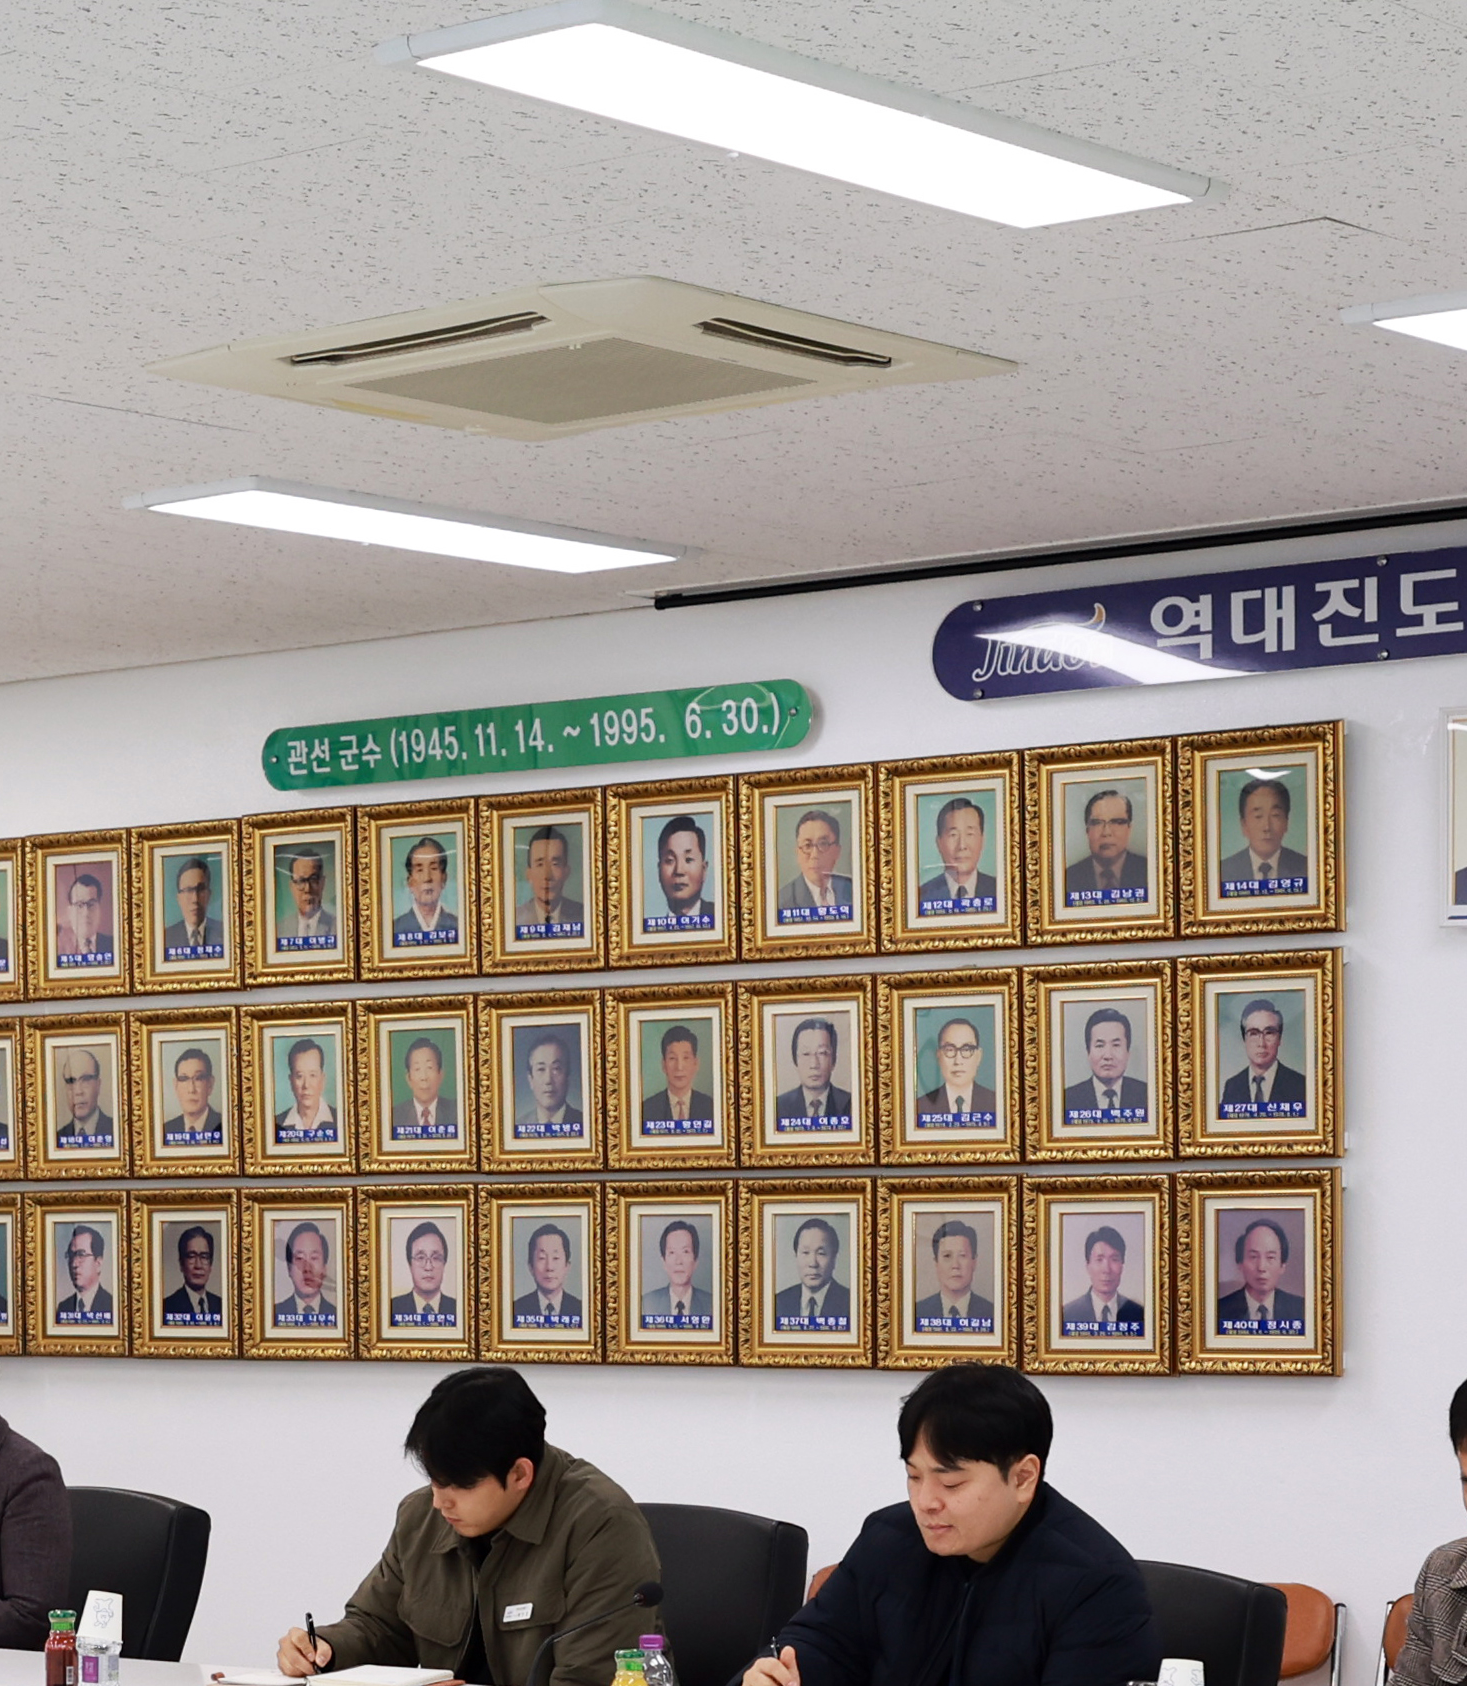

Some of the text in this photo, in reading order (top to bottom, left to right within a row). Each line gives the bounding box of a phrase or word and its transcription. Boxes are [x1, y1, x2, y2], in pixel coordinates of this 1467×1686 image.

[287, 737, 332, 776] 관선
[338, 734, 383, 771] 군수
[389, 725, 467, 769] (1945.
[475, 722, 507, 757] 11.
[515, 718, 555, 754] 14.
[591, 706, 665, 748] 1995.
[684, 700, 713, 739] 6.
[721, 694, 781, 737] 30.)
[1223, 1103, 1258, 1113] 제27대
[921, 1113, 953, 1123] 제25대
[1068, 1109, 1102, 1120] 제26대
[646, 1120, 675, 1129] 제23대
[780, 1117, 812, 1127] 제24대
[396, 1126, 422, 1135] 제21대
[517, 1124, 546, 1133] 제22대
[279, 1130, 304, 1138] 제20대
[59, 1311, 82, 1319] 제31대
[167, 1312, 191, 1321] 제32대
[277, 1313, 304, 1322] 제33대
[394, 1313, 422, 1322] 제34대
[516, 1314, 545, 1323] 제35대
[645, 1315, 675, 1324] 제36대
[780, 1316, 809, 1326] 제37대
[919, 1317, 952, 1327] 제38대
[1222, 1320, 1259, 1329] 제40대
[1065, 1322, 1099, 1331] 제39대
